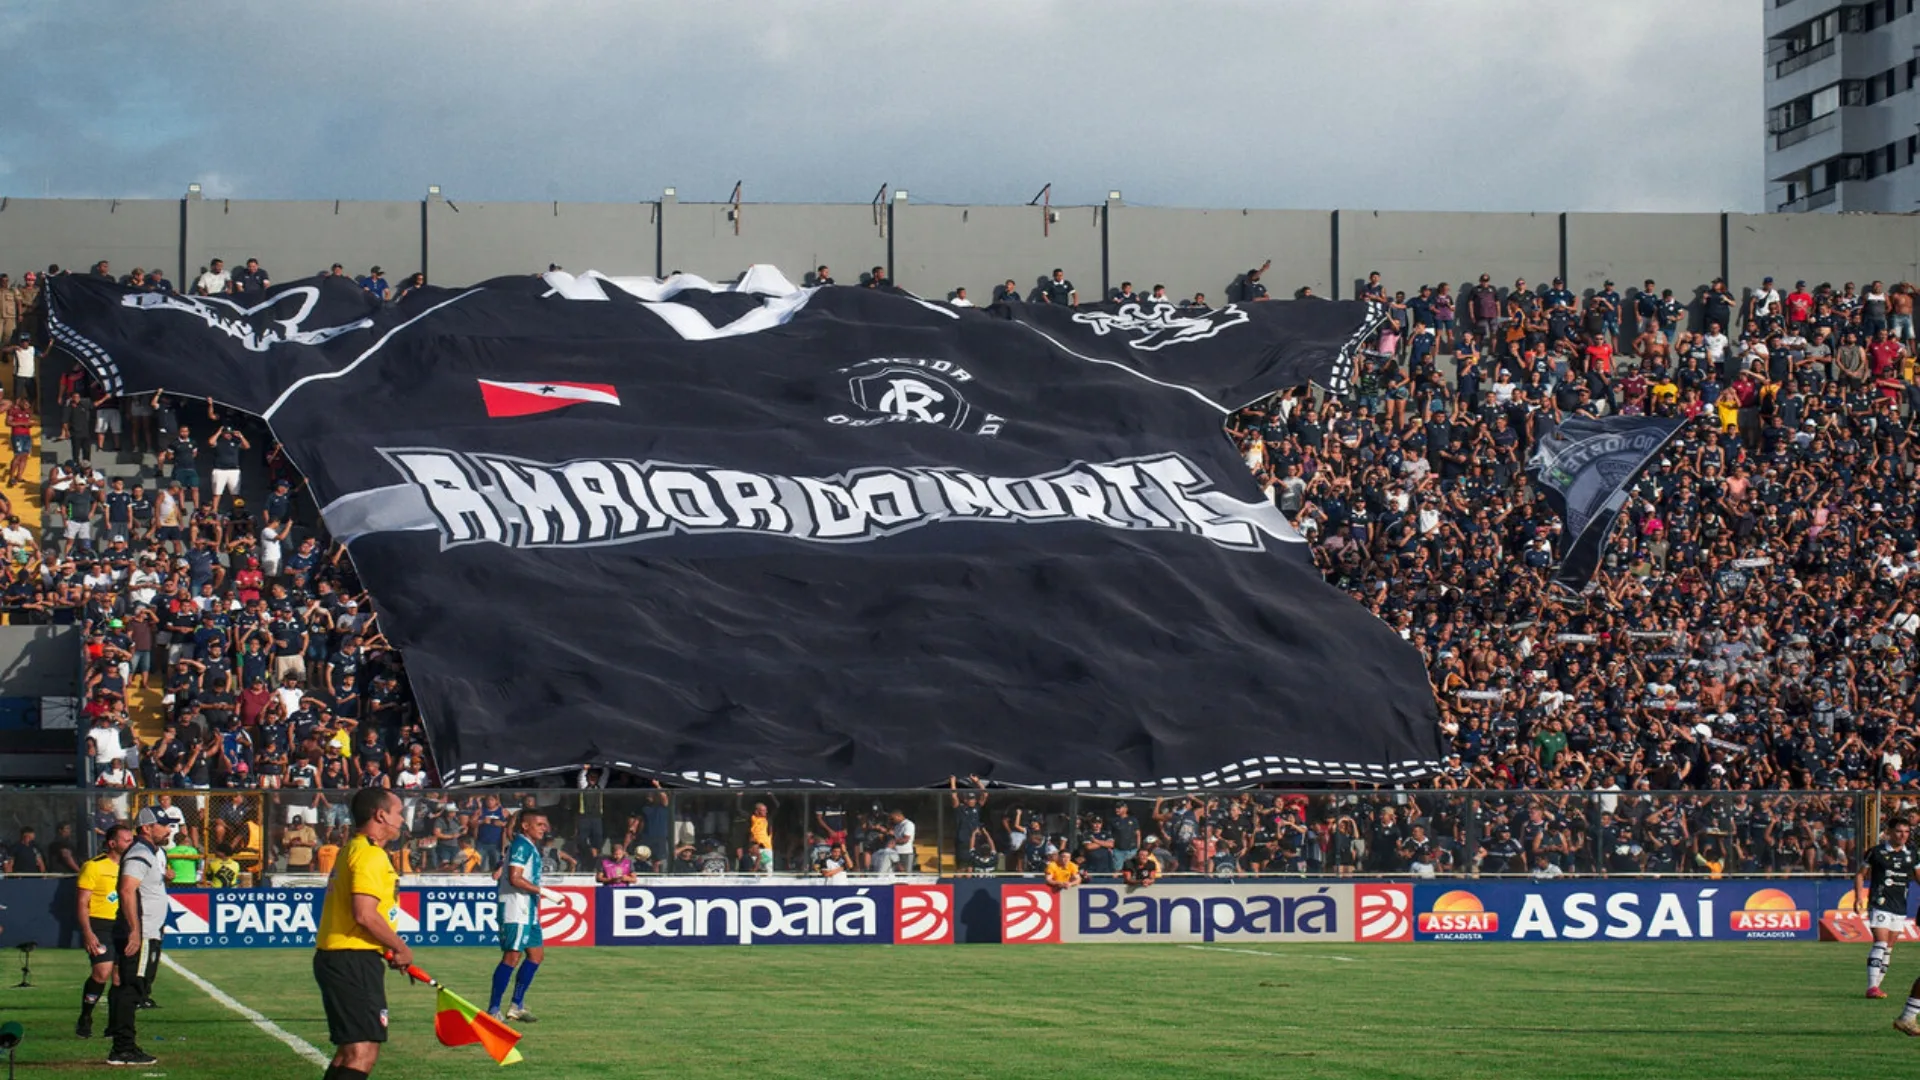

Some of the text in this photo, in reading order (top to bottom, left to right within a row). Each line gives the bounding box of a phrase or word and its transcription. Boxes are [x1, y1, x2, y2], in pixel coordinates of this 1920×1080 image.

[396, 453, 1253, 545] A MAIOR DO NORTE
[216, 892, 314, 901] GOVERNO DO
[427, 891, 497, 900] GOVERNO
[427, 902, 499, 932] PAR
[613, 888, 876, 944] Banpará
[1078, 887, 1338, 942] Banpará
[1426, 913, 1490, 930] ASSAÍ
[1511, 888, 1719, 939] ASSAÍ
[1738, 913, 1801, 928] ASSAÍ
[176, 936, 229, 945] TODO
[244, 936, 253, 944] O
[454, 934, 464, 943] O
